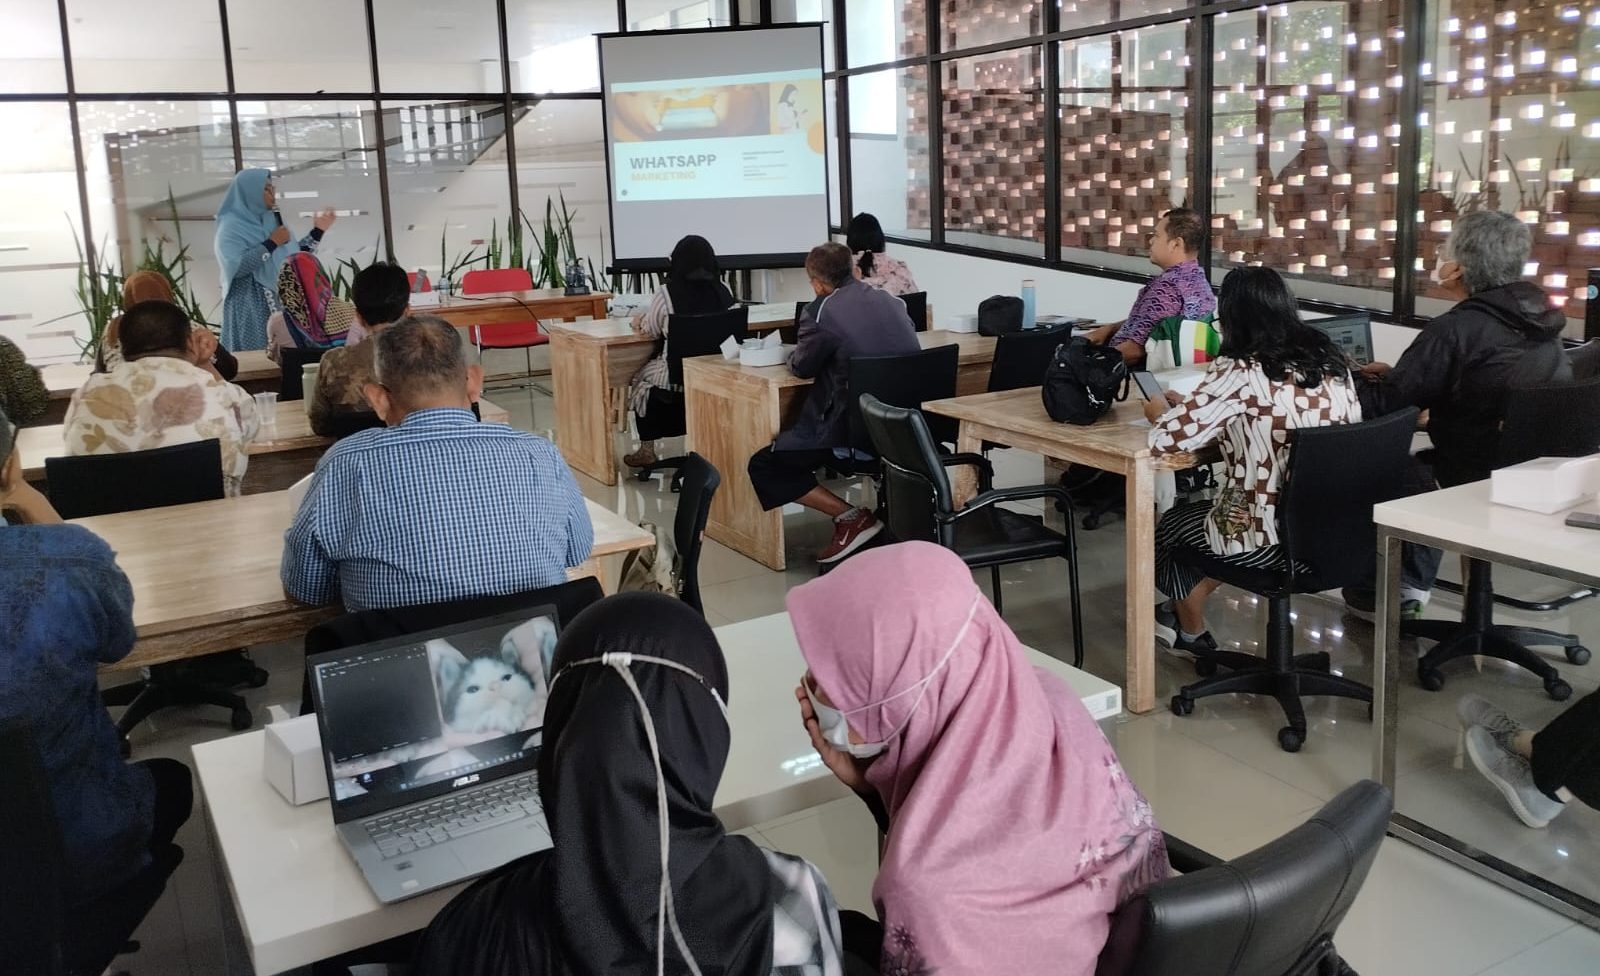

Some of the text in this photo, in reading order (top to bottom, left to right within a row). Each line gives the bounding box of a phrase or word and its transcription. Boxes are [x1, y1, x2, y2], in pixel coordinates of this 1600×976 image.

[629, 154, 717, 169] WHATSAPP
[631, 171, 696, 181] MARKETING
[452, 774, 480, 787] ASUS
